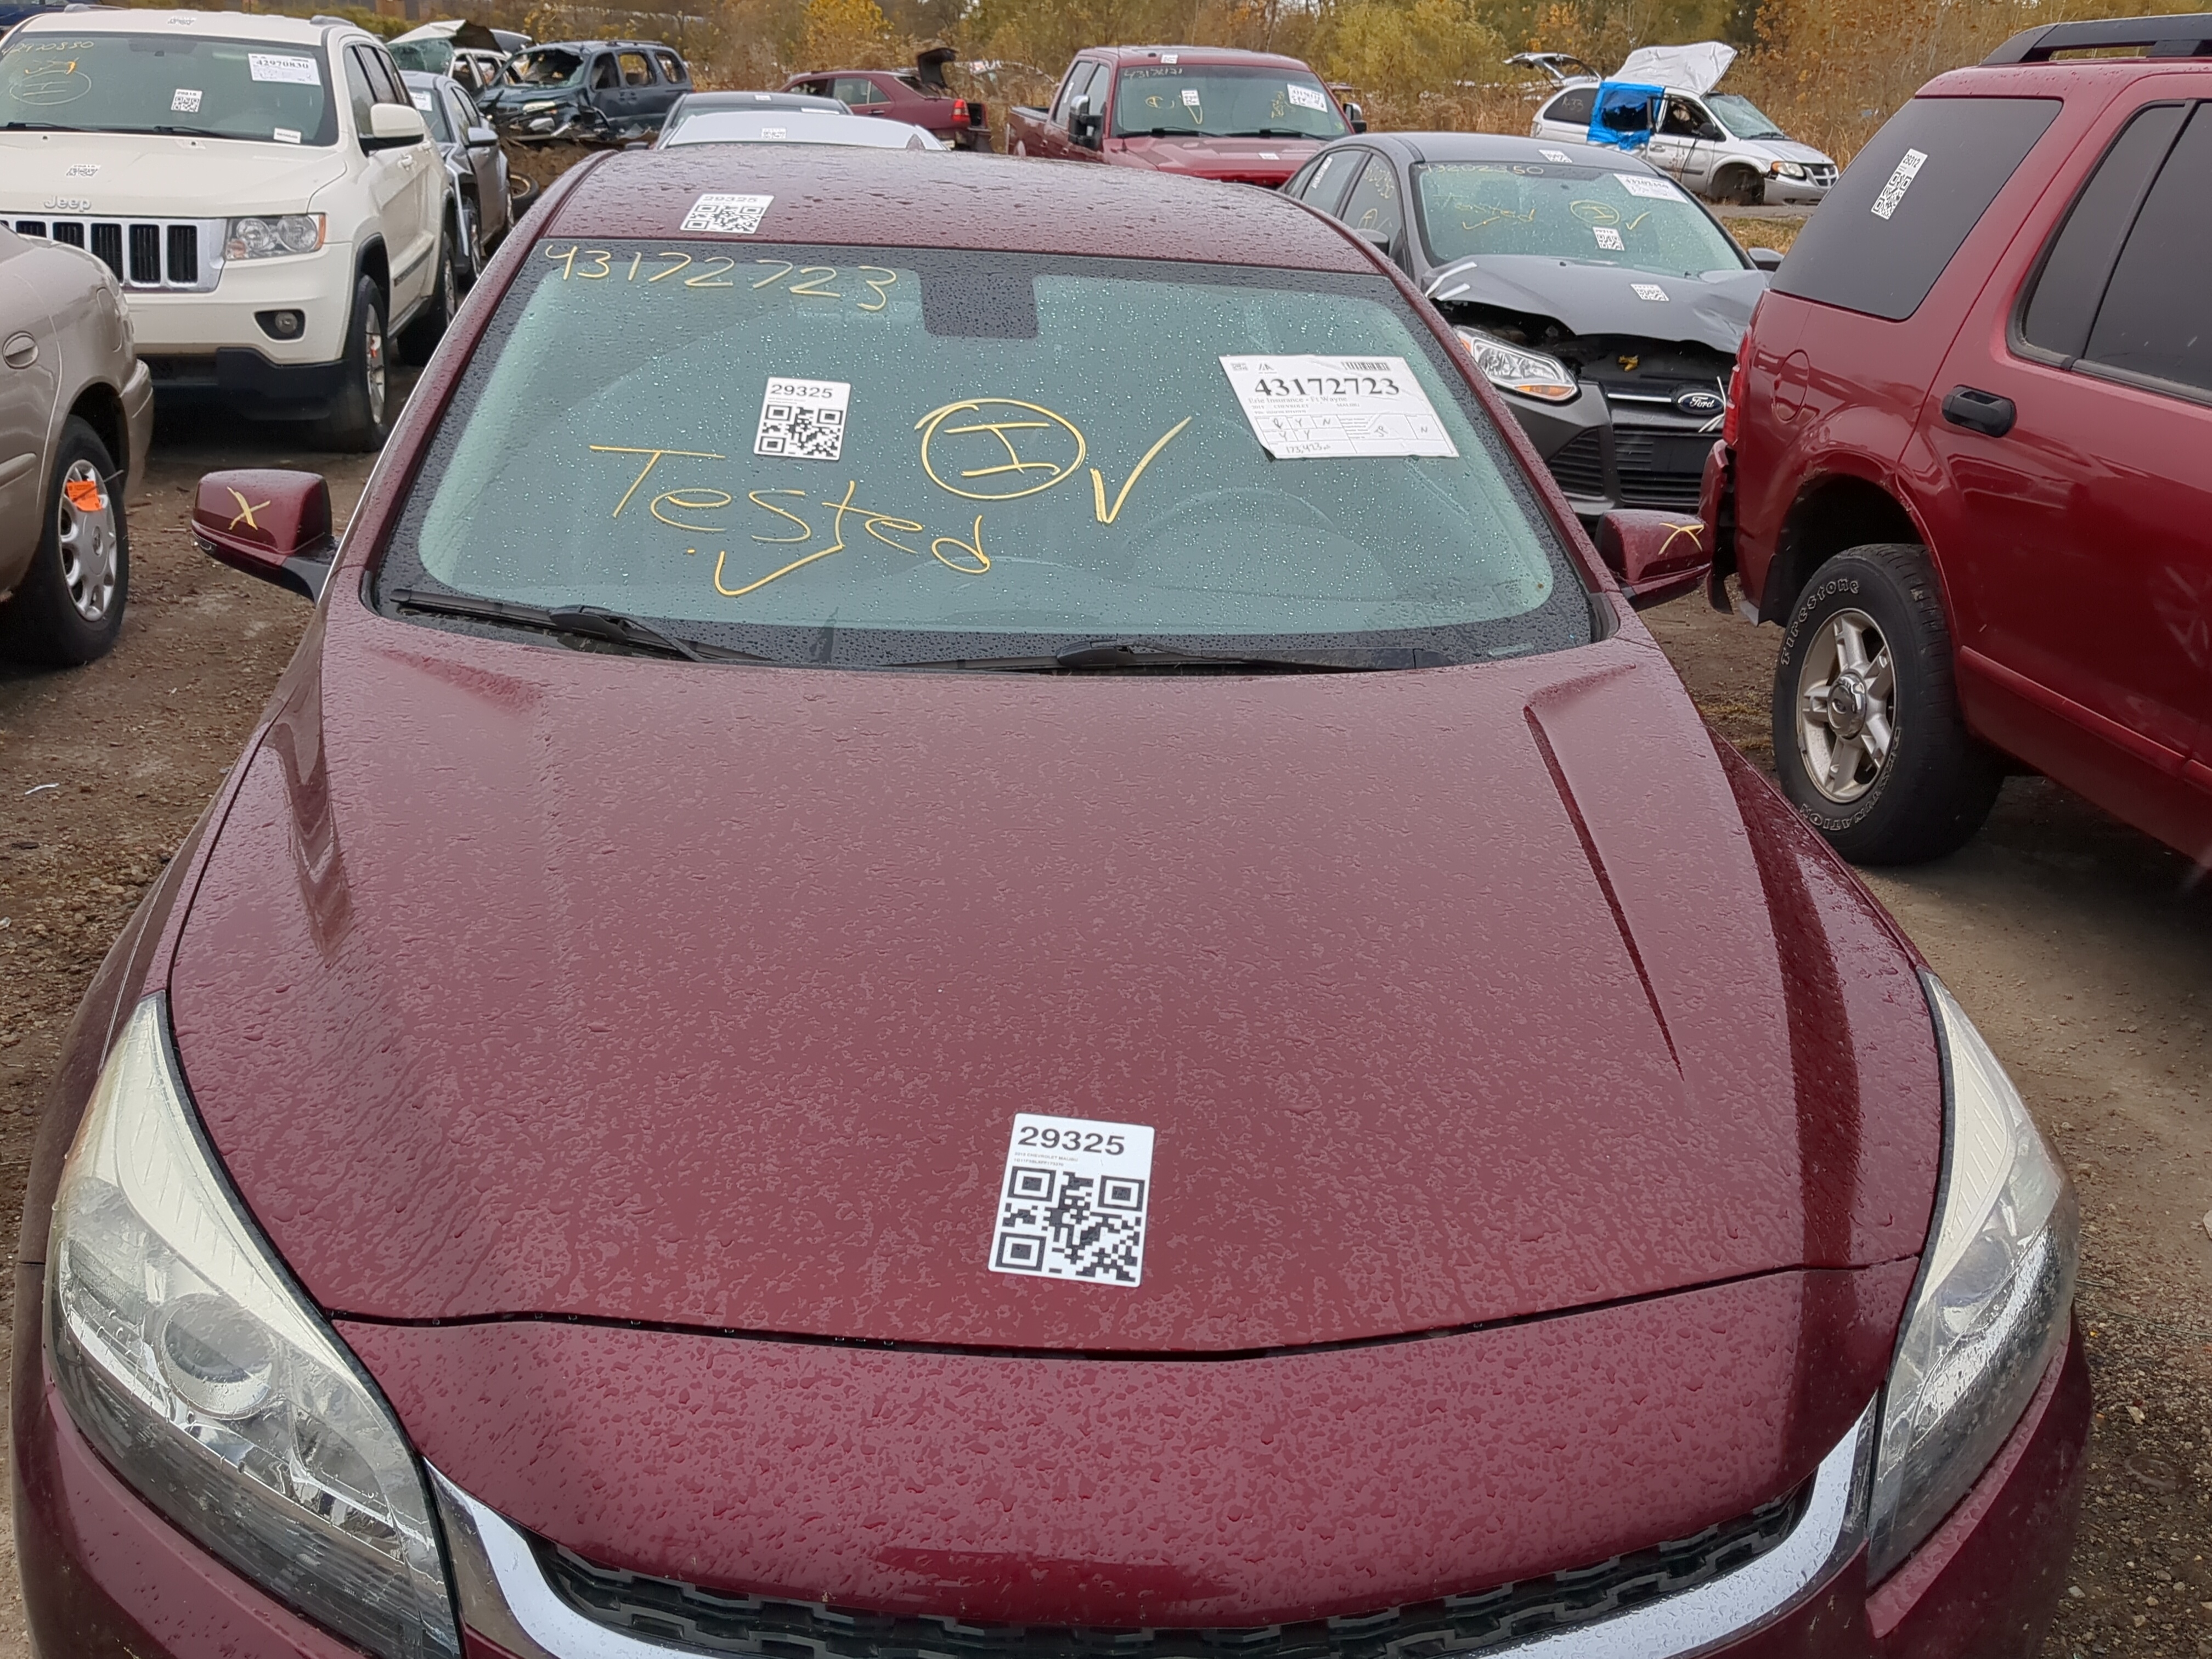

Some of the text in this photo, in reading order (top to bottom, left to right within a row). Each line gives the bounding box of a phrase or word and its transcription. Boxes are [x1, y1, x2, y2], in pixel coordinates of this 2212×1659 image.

[1903, 154, 1921, 168] 29312
[44, 195, 92, 212] Jeep
[545, 244, 898, 311] 43172723
[770, 384, 833, 399] 29325
[1254, 377, 1400, 396] 43172723
[1320, 395, 1347, 403] Wayne
[1690, 396, 1715, 408] Ford
[589, 444, 991, 576] Tested
[1780, 578, 1860, 666] Firestone
[1799, 725, 1903, 831] DESTINATION
[1017, 1126, 1125, 1156] 29325
